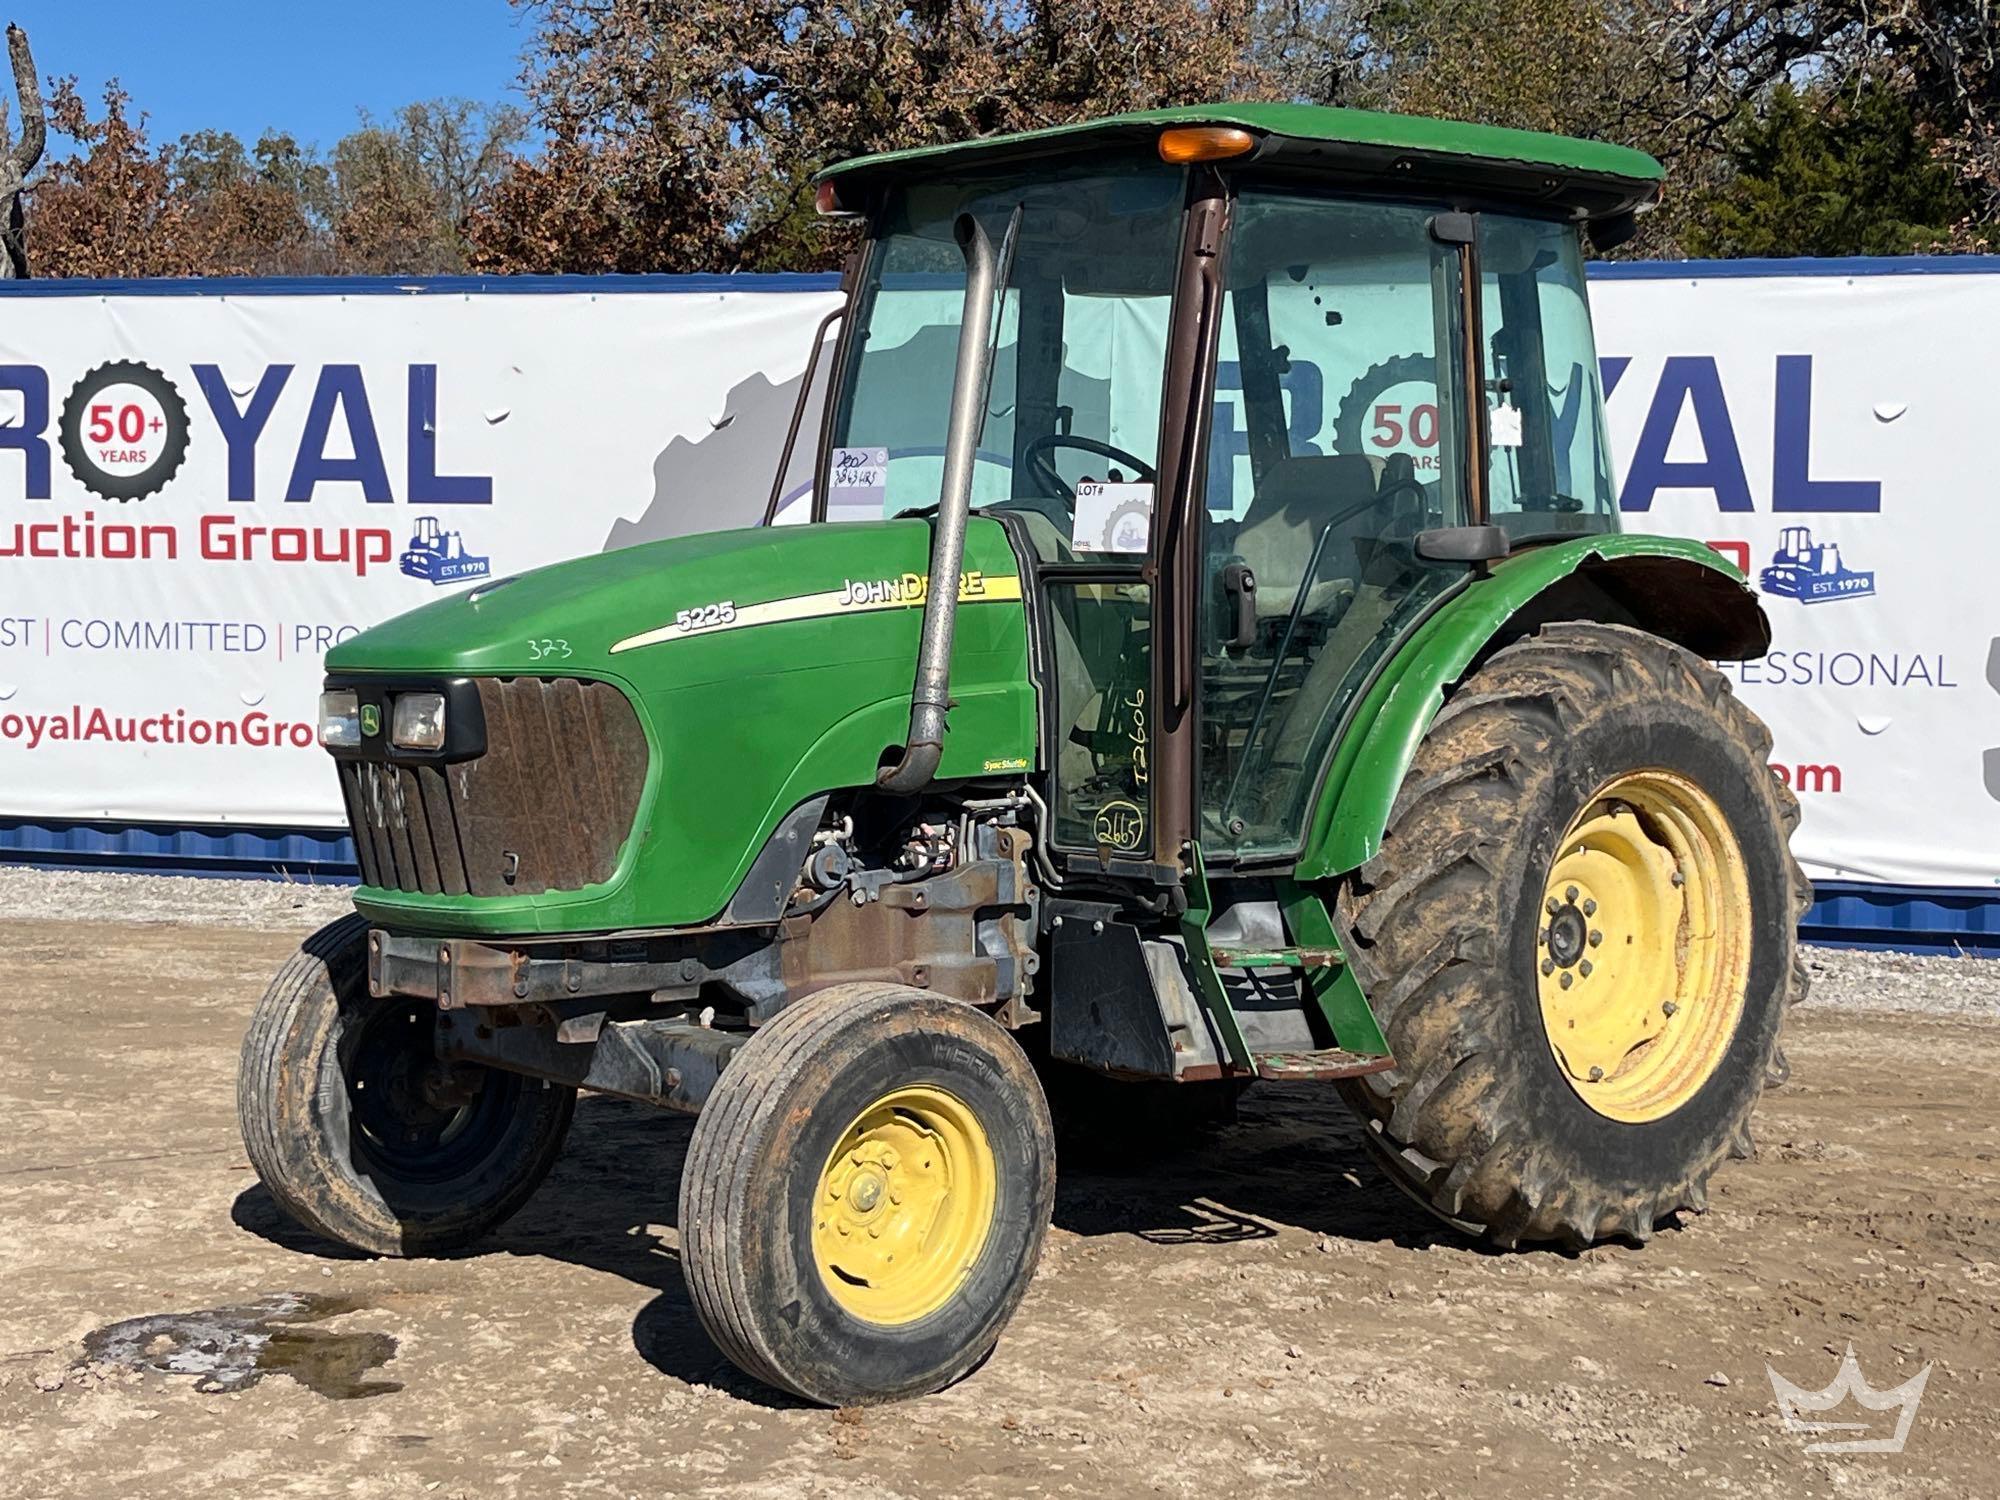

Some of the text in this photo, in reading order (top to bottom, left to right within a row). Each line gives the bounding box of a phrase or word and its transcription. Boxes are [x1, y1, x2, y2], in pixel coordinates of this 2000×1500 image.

[88, 404, 163, 443] 50+
[100, 449, 147, 463] YEARS
[1078, 485, 1104, 496] LOT#
[200, 515, 392, 577] Group
[441, 563, 486, 576] EST. 1970
[1812, 578, 1869, 594] EST. 1970
[676, 600, 737, 632] 5225
[61, 619, 266, 652] COMMITTED
[528, 638, 573, 660] 323
[0, 705, 325, 749] oyalAuctionGro
